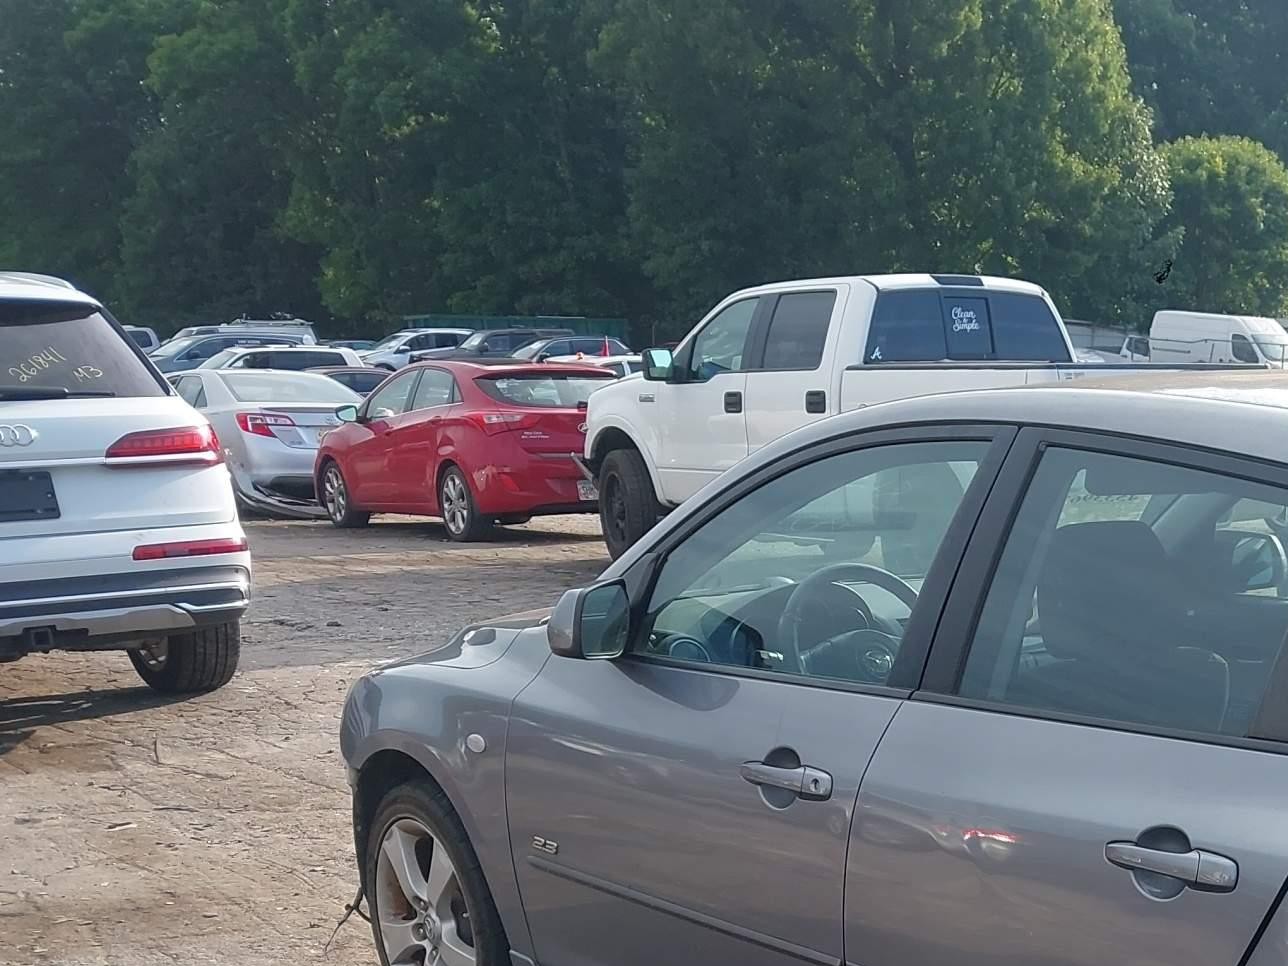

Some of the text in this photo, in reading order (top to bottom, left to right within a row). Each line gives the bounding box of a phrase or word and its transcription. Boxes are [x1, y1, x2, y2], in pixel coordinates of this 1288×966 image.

[951, 306, 977, 320] Clean
[952, 319, 980, 333] Simple
[8, 345, 67, 383] 261841
[73, 365, 104, 383] M3
